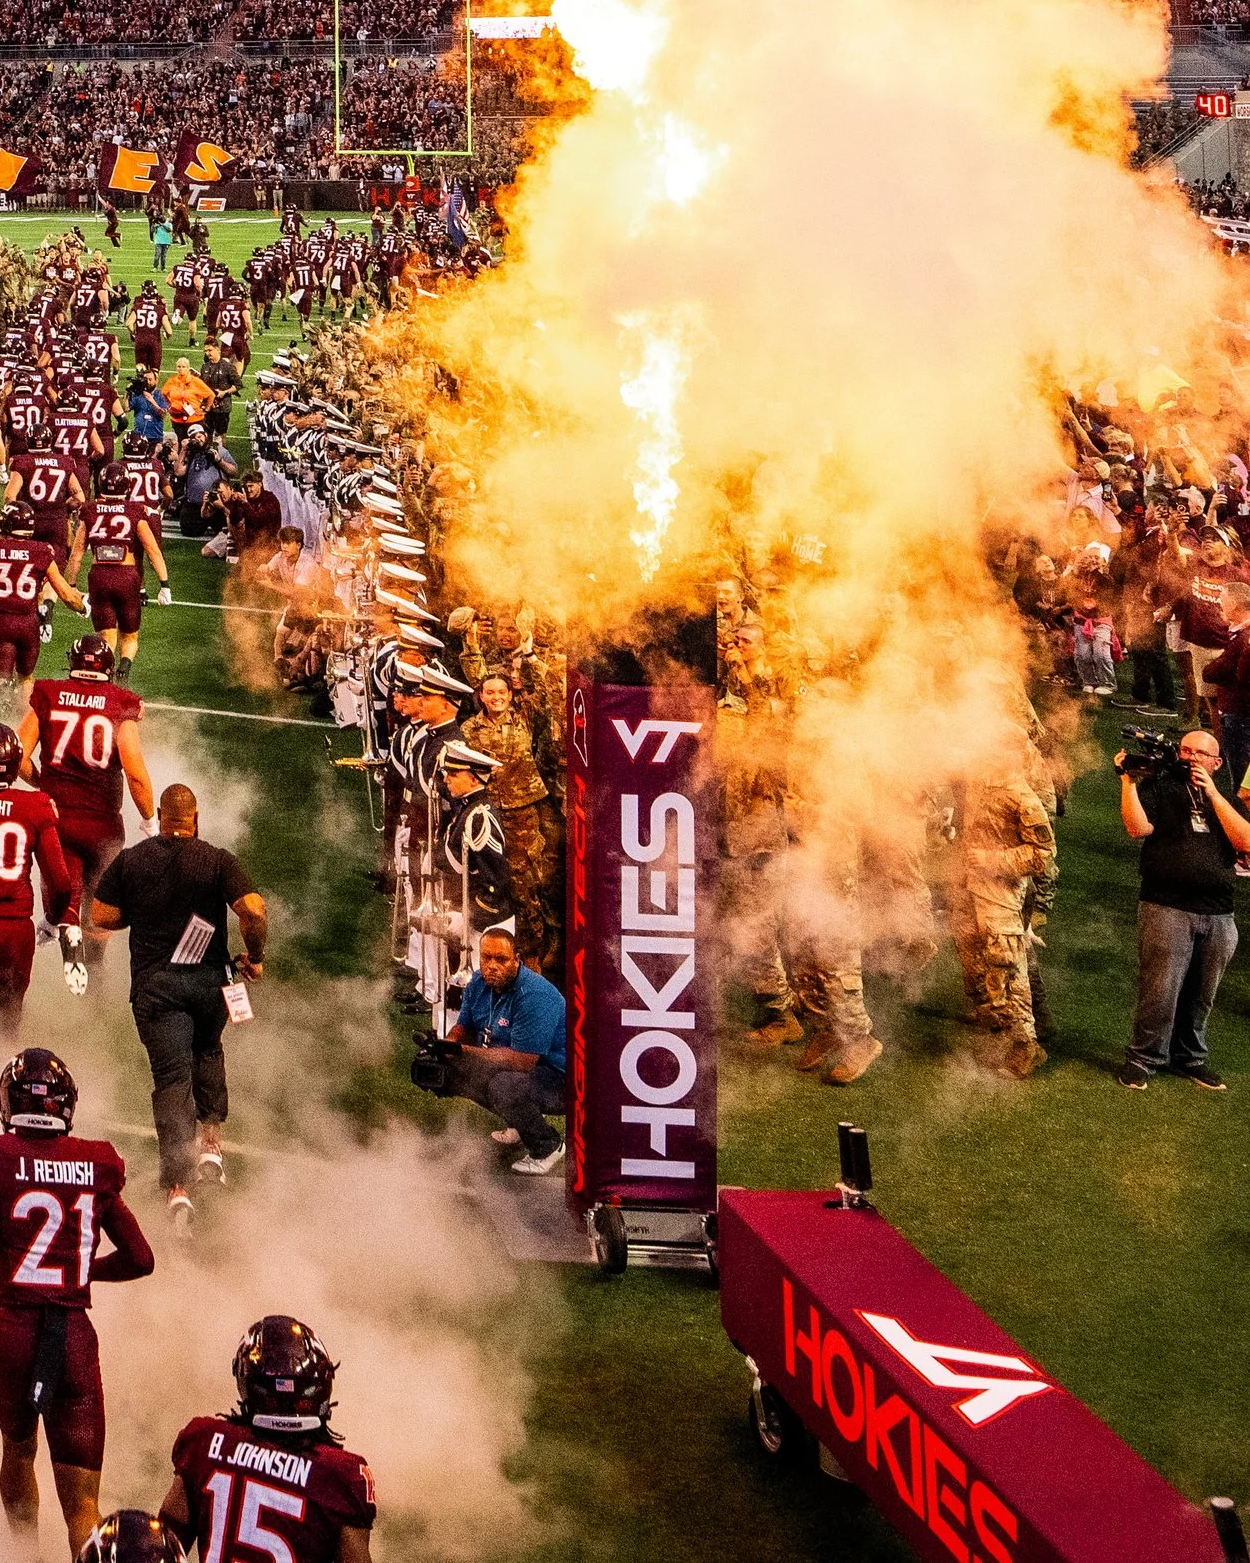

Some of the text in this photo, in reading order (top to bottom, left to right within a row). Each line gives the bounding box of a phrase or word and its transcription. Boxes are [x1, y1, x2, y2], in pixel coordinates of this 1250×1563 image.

[1199, 95, 1227, 116] 40
[175, 271, 193, 287] 45
[208, 283, 224, 299] 71
[76, 289, 96, 307] 57
[136, 309, 158, 329] 58
[221, 310, 241, 328] 93
[85, 341, 110, 363] 82
[15, 397, 33, 405] TAYLOR
[79, 397, 106, 424] 76
[9, 405, 41, 430] 50
[54, 427, 89, 456] 44
[28, 467, 66, 503] 67
[128, 471, 160, 503] 20
[96, 504, 125, 514] STEVENS
[88, 515, 131, 541] 42
[8, 549, 30, 561] JONES
[58, 691, 107, 710] STALLARD
[49, 710, 114, 769] 70
[611, 718, 703, 764] VT
[573, 773, 587, 1195] VIRGINIA TECH
[618, 791, 698, 1180] HOKIES
[15, 1156, 94, 1186] J. REDDISH
[12, 1191, 95, 1288] 21
[271, 1420, 303, 1429] HOKIES
[783, 1277, 1019, 1563] HOKIES
[208, 1432, 313, 1488] B. JOHNSON
[205, 1471, 304, 1563] 15
